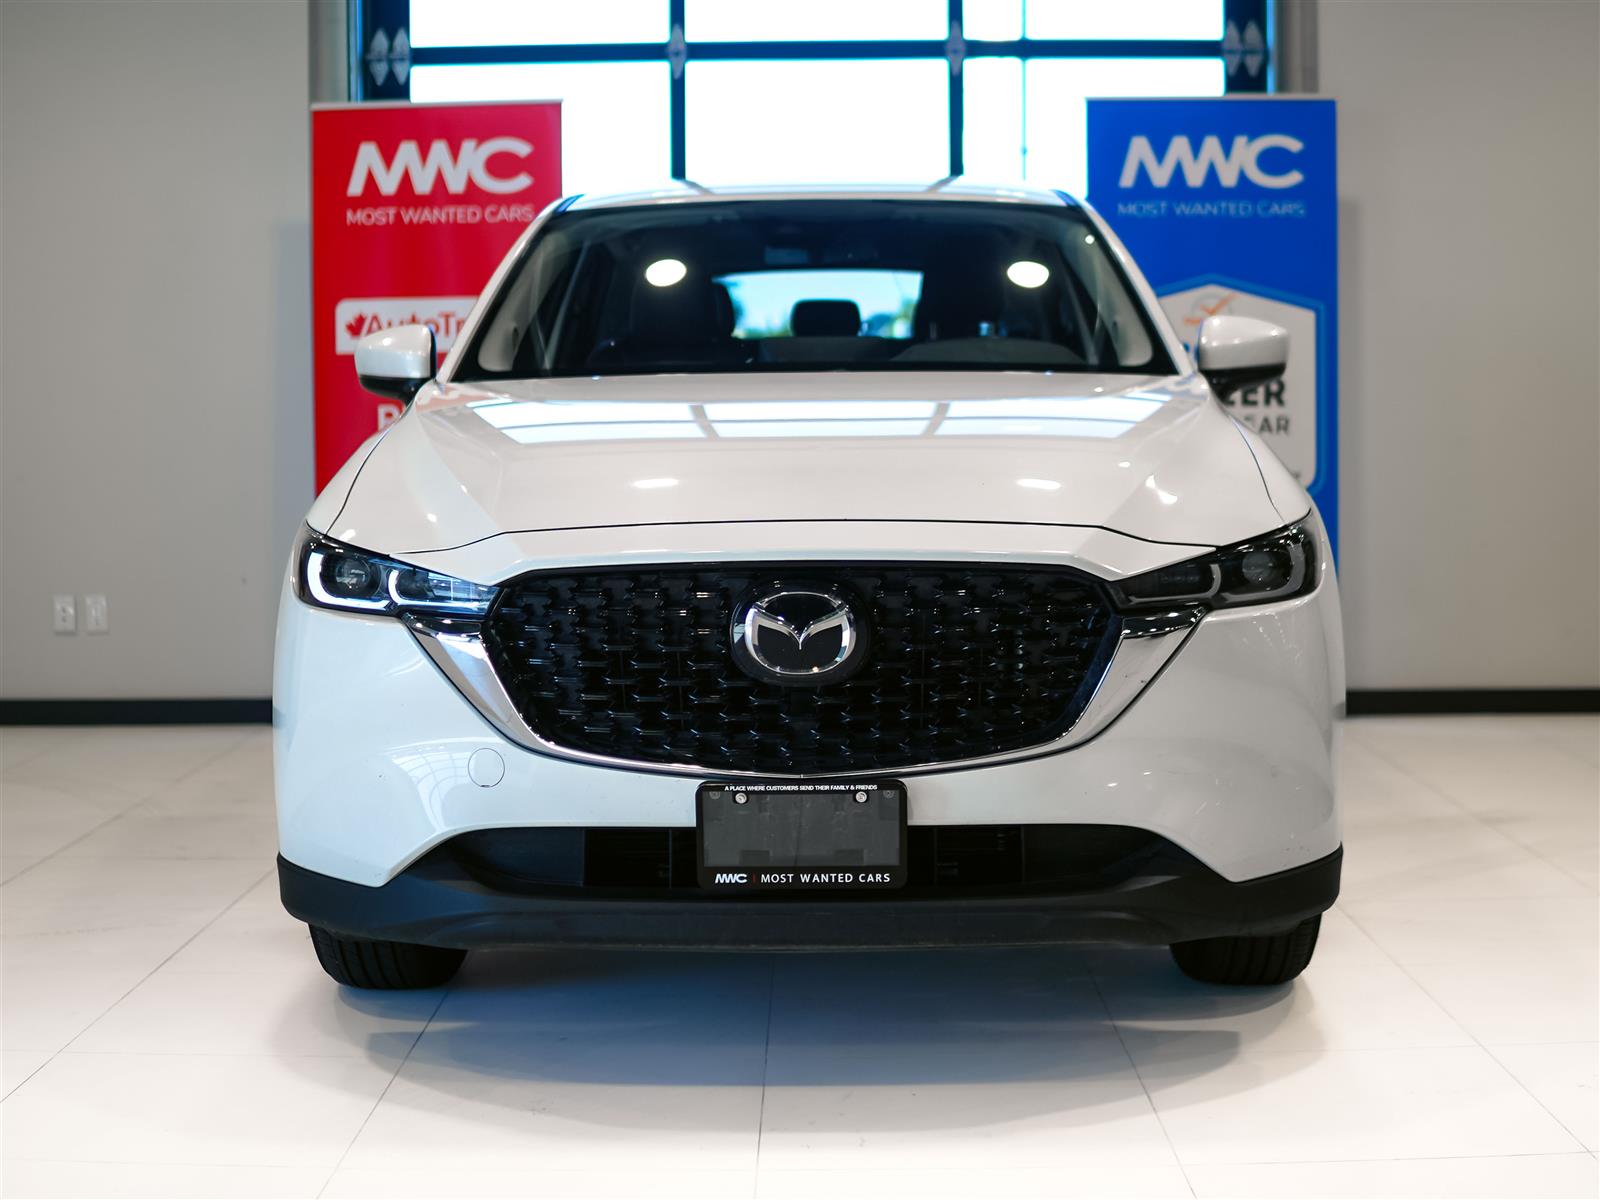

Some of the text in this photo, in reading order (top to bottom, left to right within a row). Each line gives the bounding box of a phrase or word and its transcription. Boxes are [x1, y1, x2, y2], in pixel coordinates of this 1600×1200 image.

[347, 137, 533, 197] MWC
[1119, 134, 1304, 189] MWC
[346, 205, 535, 226] MOST WANTED CARS
[1118, 202, 1306, 217] MOST WANTED CARS
[714, 872, 891, 884] MWC MOST WANTED CARS
